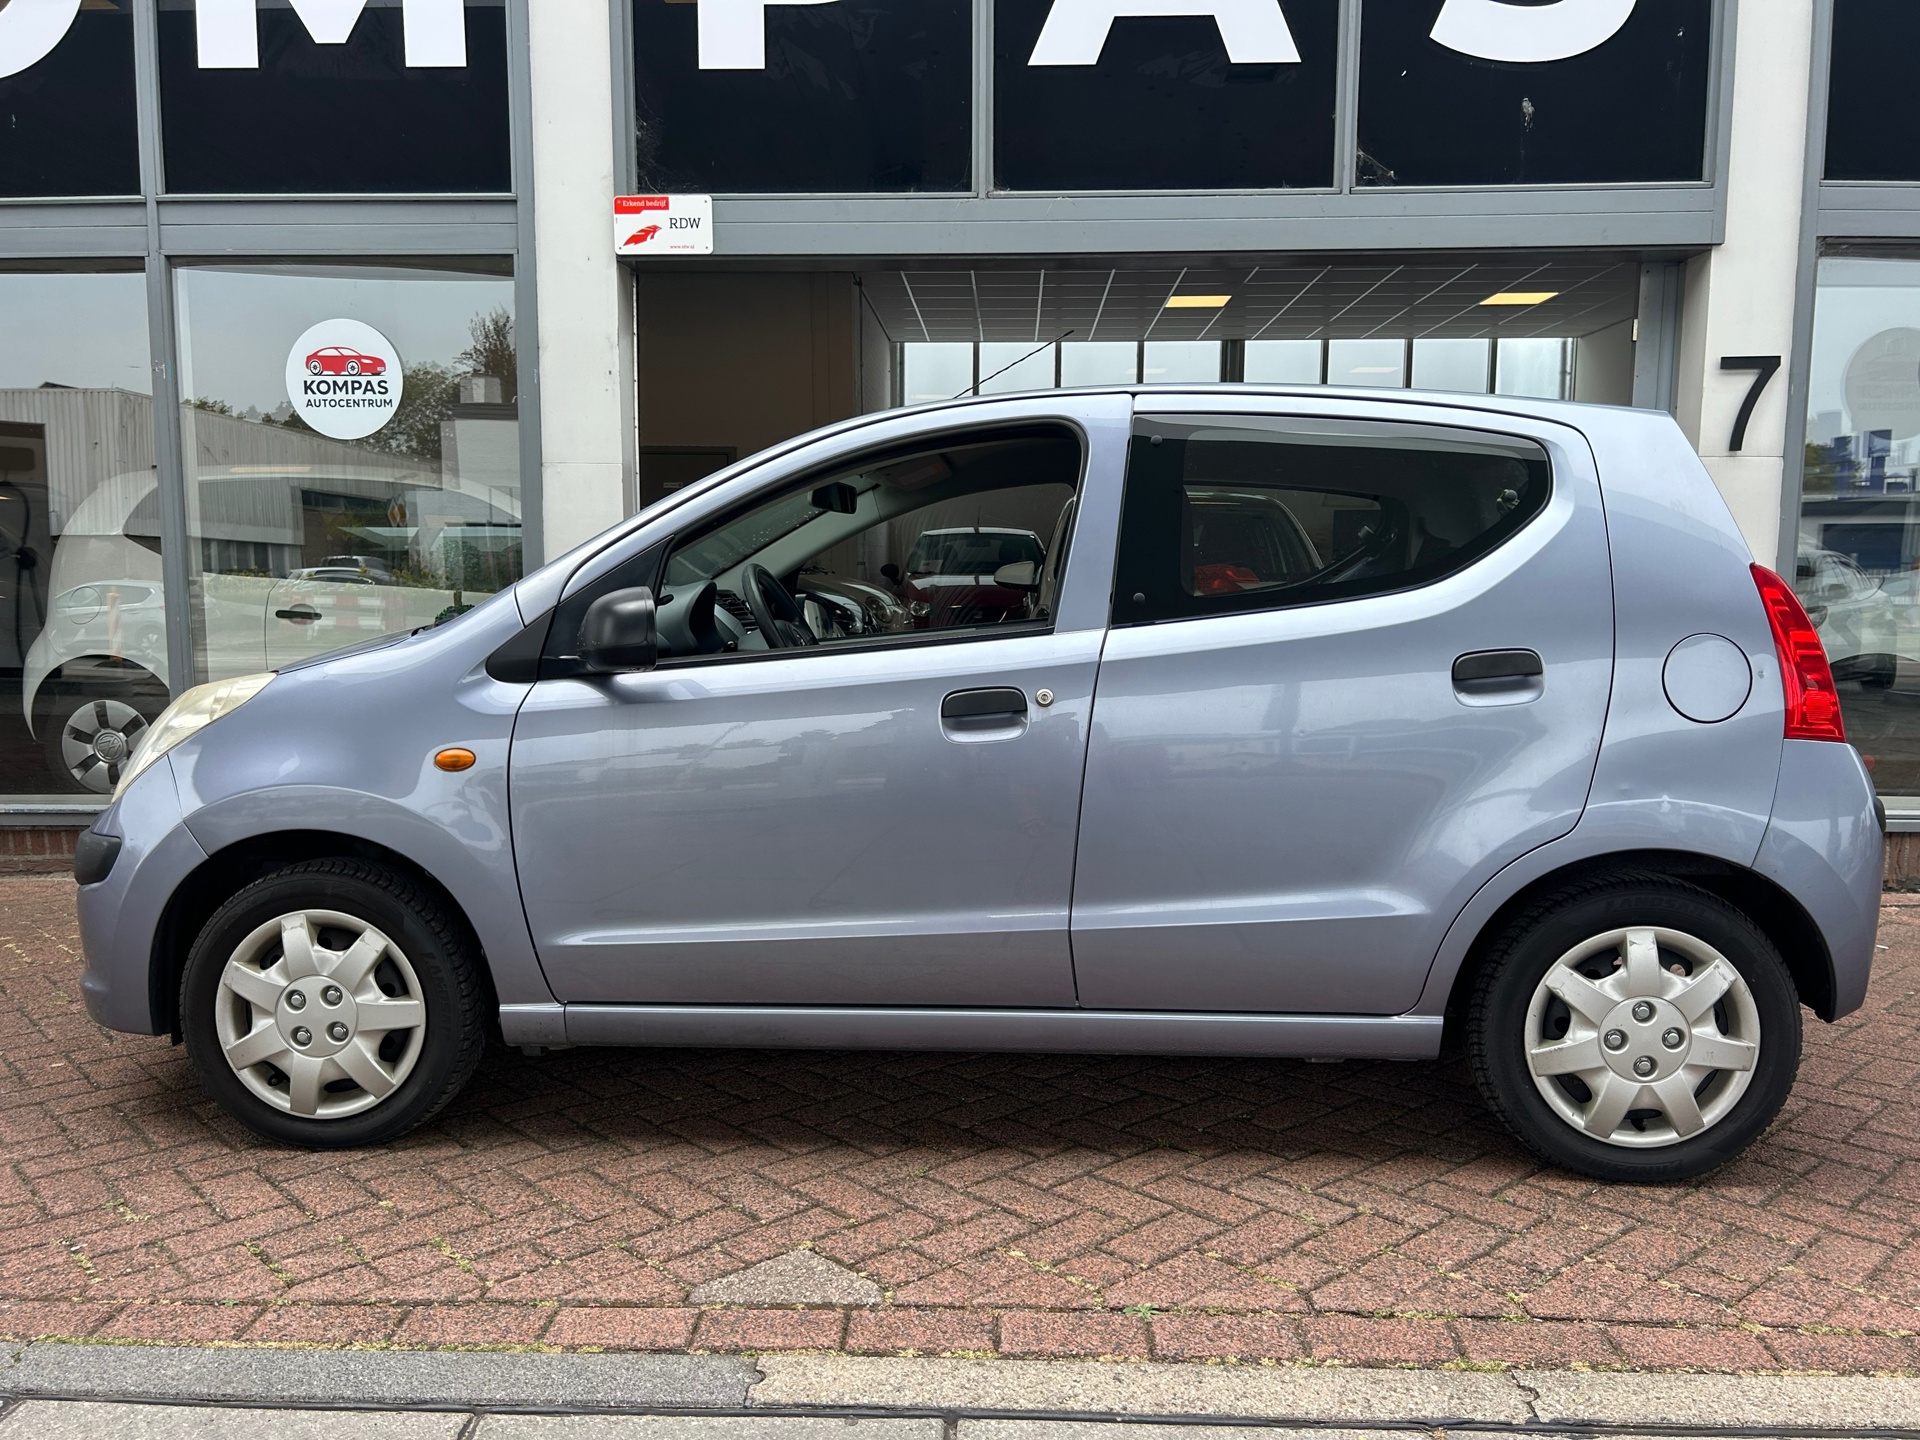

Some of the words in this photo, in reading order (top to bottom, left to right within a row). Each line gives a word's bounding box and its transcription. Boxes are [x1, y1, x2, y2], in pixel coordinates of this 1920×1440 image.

[622, 199, 645, 207] Erkend
[645, 199, 667, 208] bedrijf
[669, 217, 701, 229] RDW
[303, 379, 389, 395] KOMPAS
[305, 398, 393, 408] AUTOCENTRUM
[1720, 355, 1781, 452] 7
